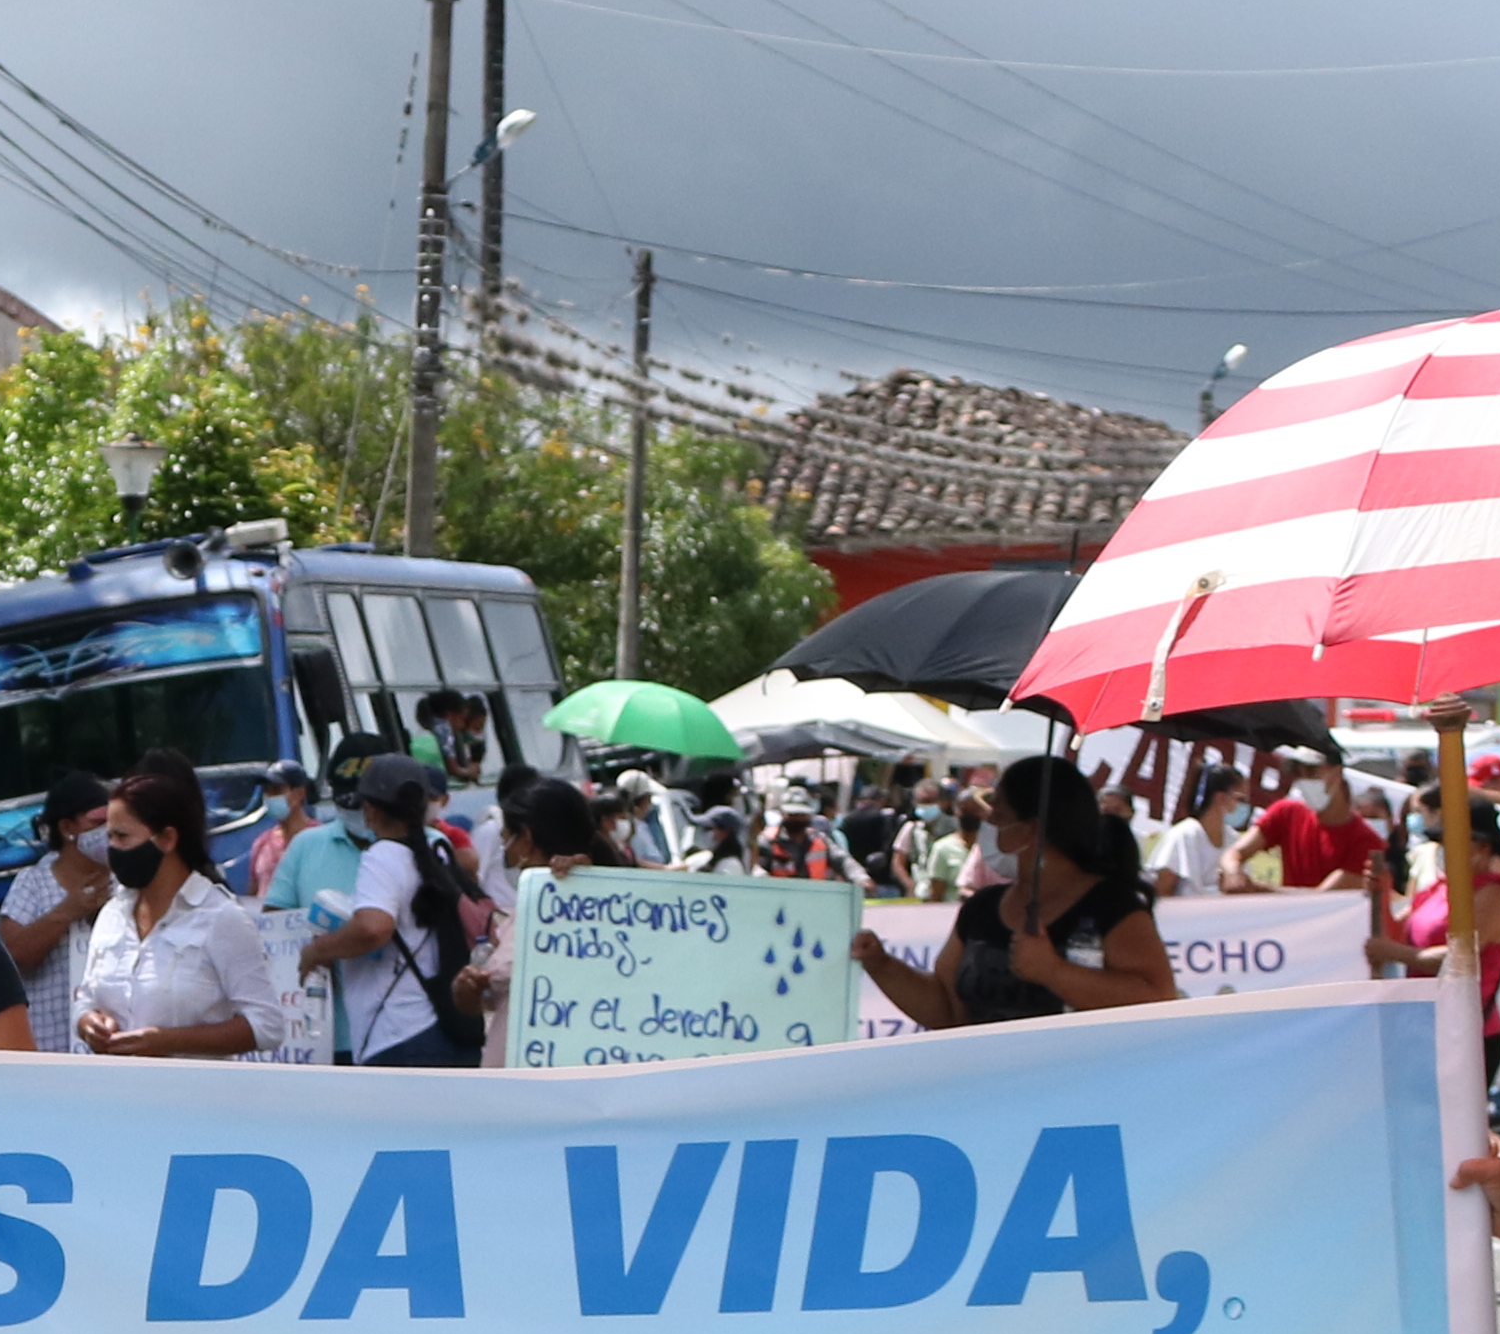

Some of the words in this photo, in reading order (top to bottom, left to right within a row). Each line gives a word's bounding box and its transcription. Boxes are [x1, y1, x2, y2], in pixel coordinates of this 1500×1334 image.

[1163, 939, 1286, 974] ECHO
[528, 975, 579, 1028] Por
[590, 997, 627, 1033] el
[639, 993, 759, 1042] derecho
[145, 1149, 465, 1322] DA
